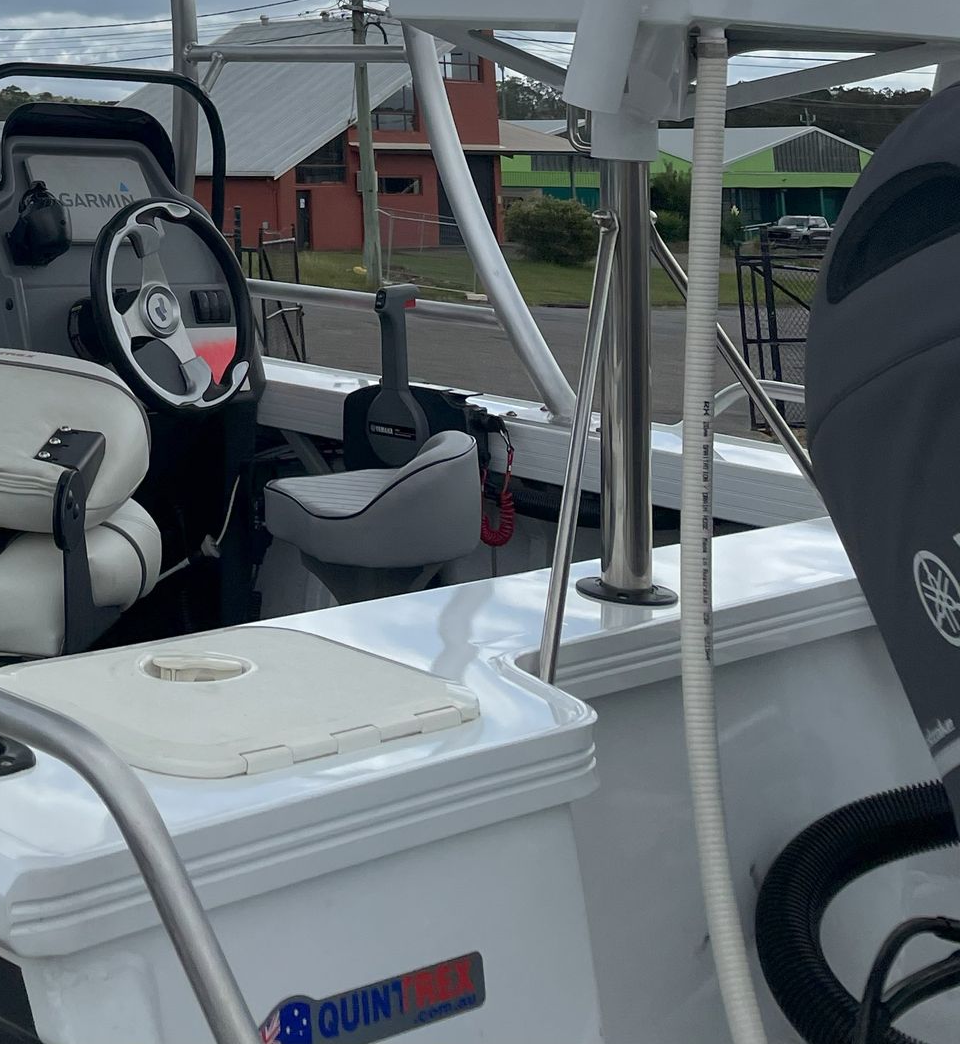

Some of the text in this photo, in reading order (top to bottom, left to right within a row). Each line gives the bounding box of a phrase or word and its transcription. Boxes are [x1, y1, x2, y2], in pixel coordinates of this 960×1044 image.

[59, 192, 136, 208] GARMIN
[318, 958, 475, 1039] QUINTREX
[414, 993, 477, 1024] .com.au
